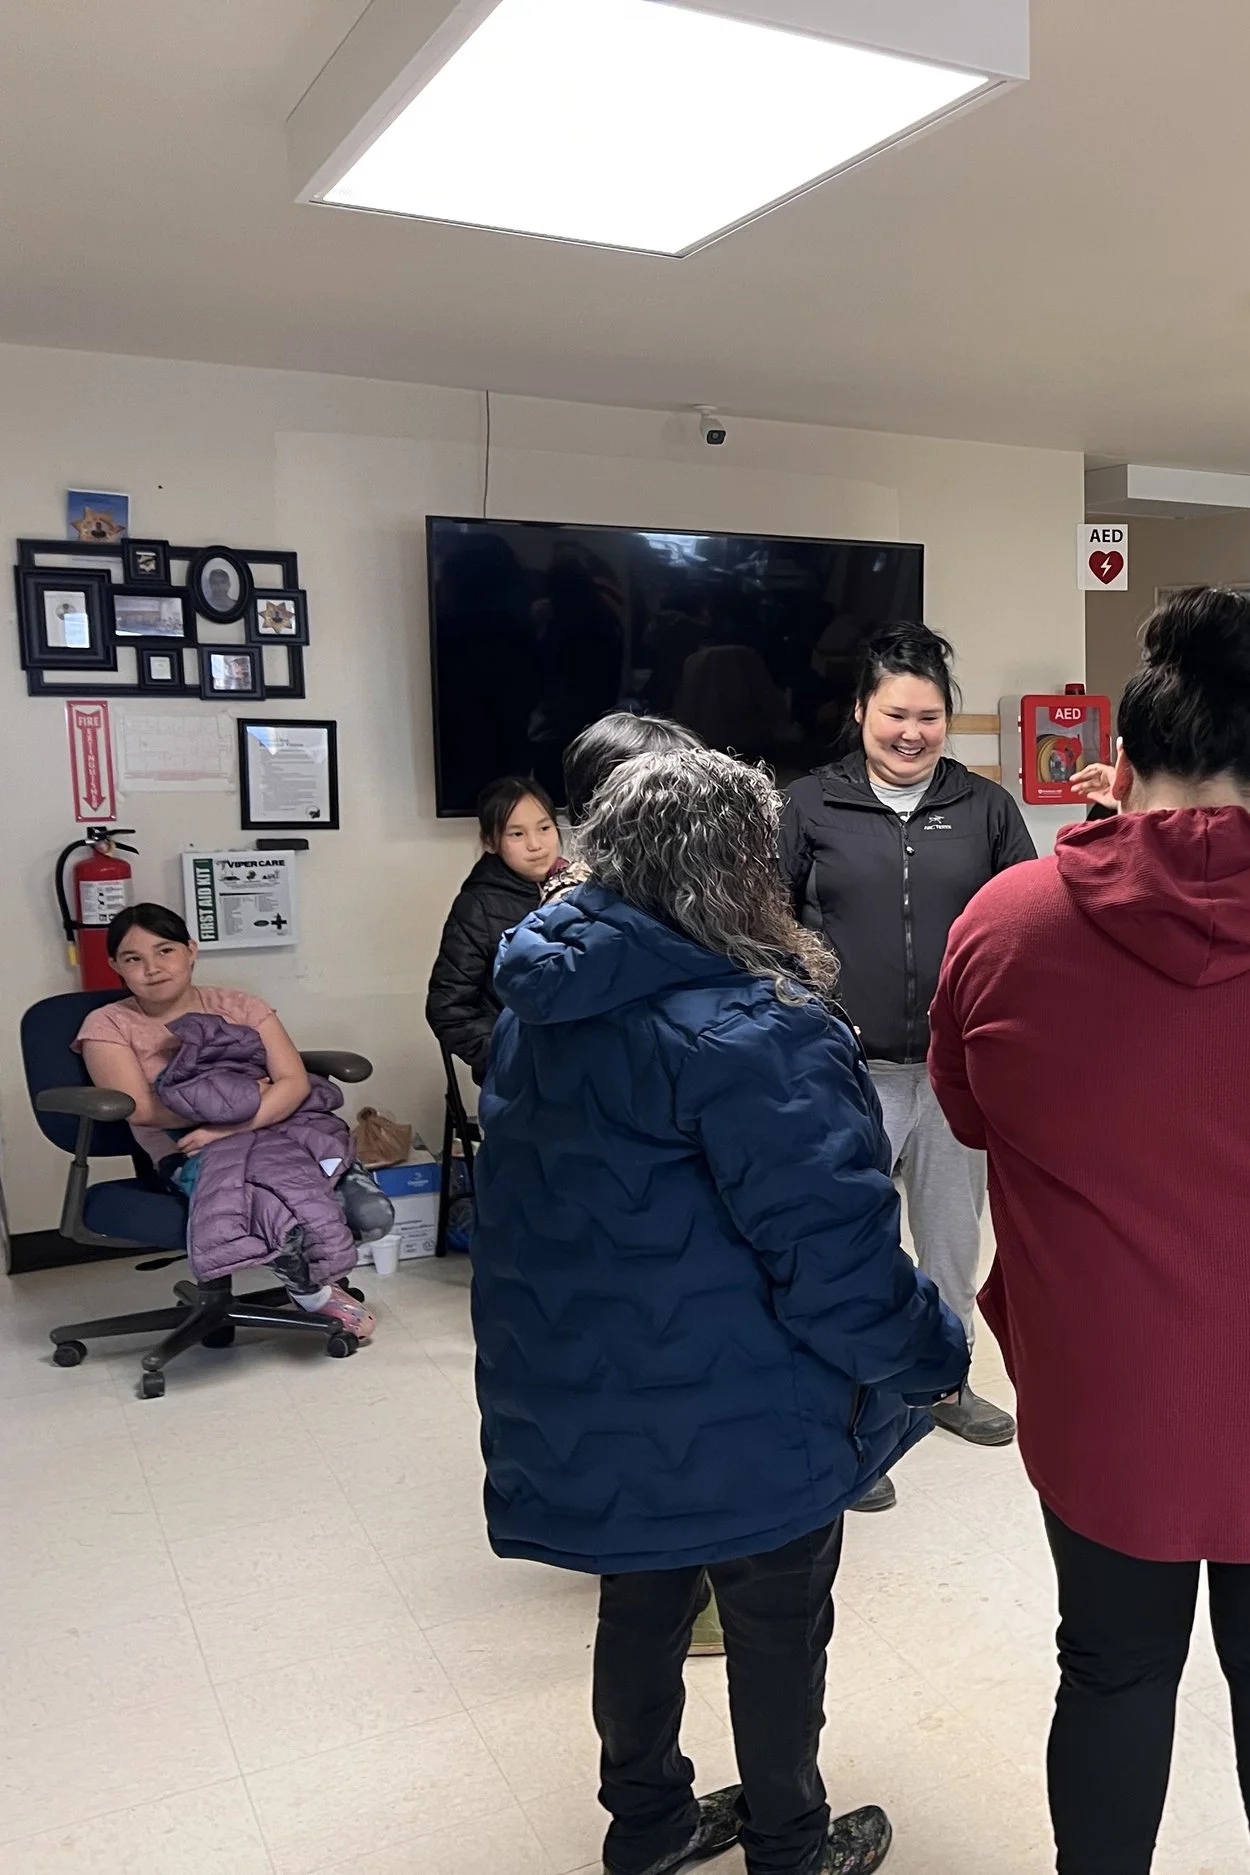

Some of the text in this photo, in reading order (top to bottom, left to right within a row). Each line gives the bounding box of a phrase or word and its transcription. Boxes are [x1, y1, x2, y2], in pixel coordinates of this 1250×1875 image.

[1089, 528, 1124, 543] AED
[1054, 707, 1081, 720] AED
[78, 716, 100, 726] FIRE
[226, 859, 285, 868] VIPER CARE
[195, 867, 216, 940] FIRST AID KIT
